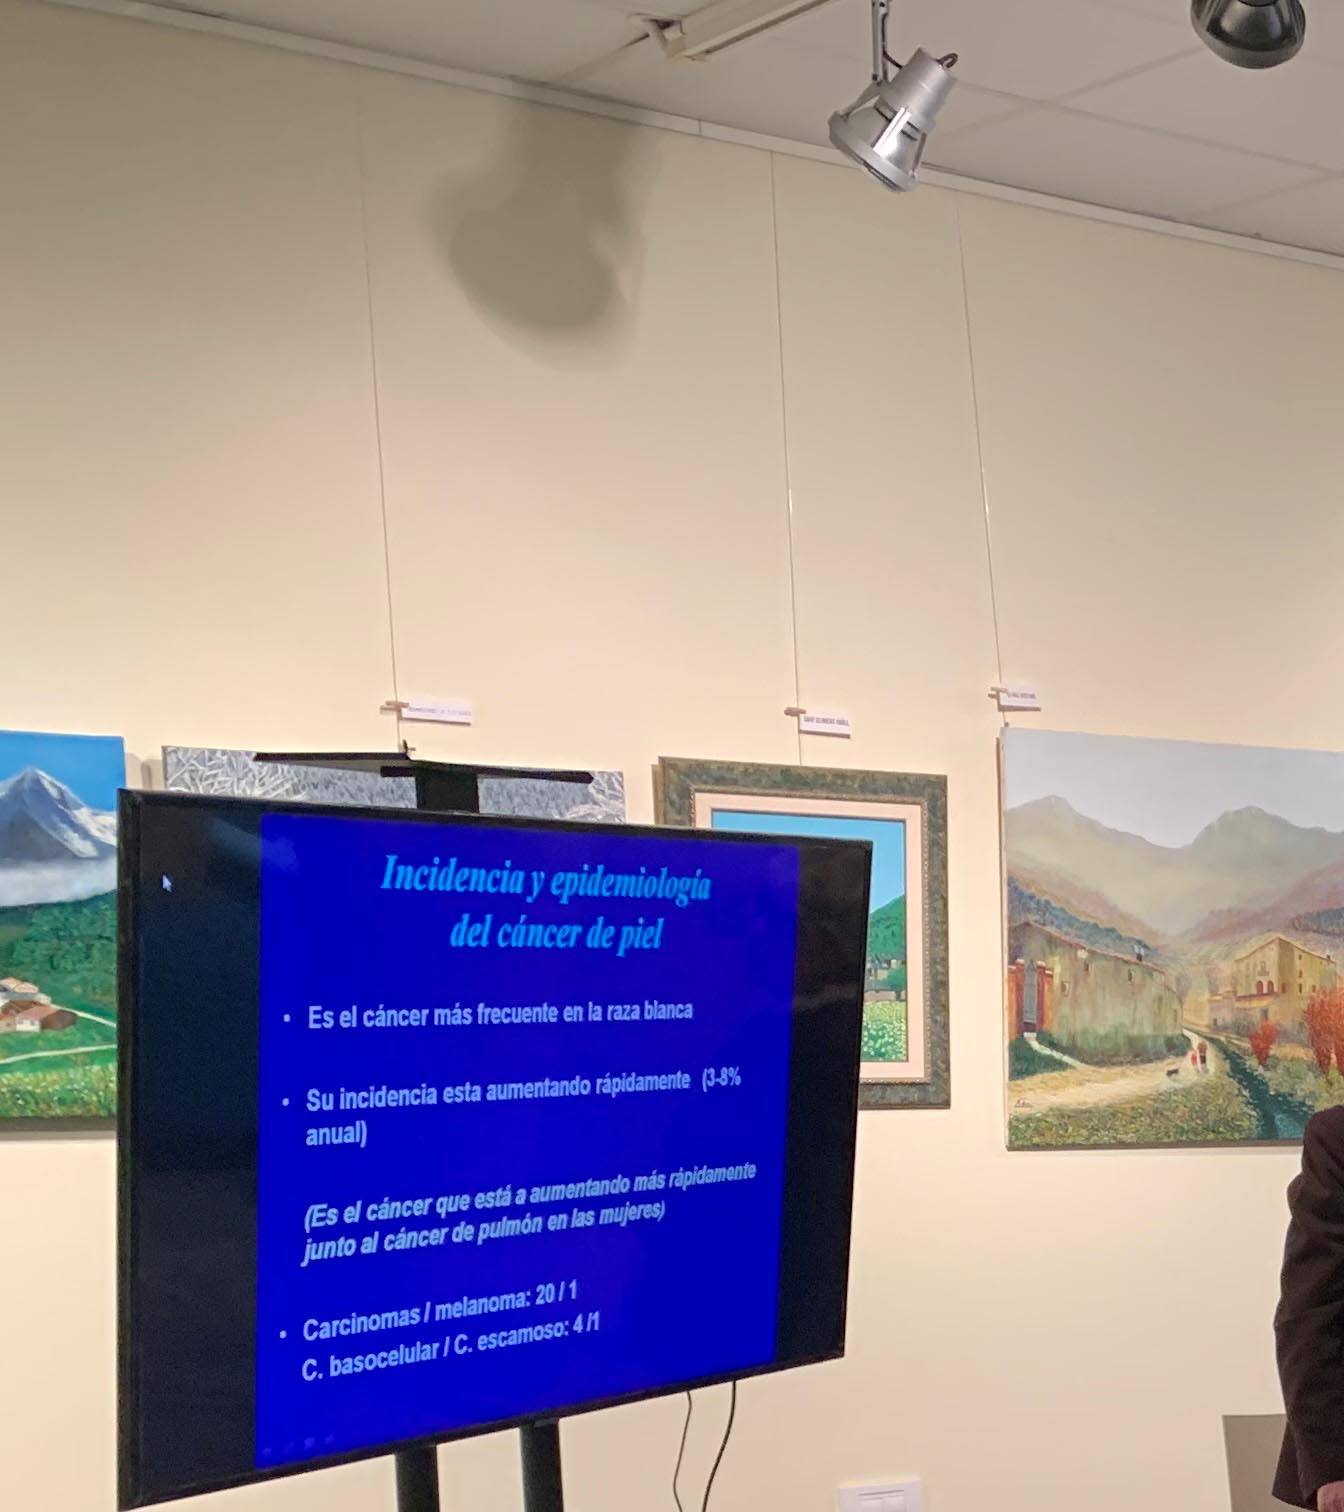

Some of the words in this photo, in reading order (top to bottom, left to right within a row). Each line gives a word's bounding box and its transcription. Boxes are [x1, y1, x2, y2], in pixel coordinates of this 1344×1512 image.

[380, 855, 525, 893] Incidencia
[526, 871, 545, 903] y
[550, 864, 712, 907] epidemiología
[450, 913, 493, 947] del
[497, 914, 582, 948] cáncer
[586, 916, 615, 948] de
[616, 917, 664, 957] piel
[308, 1005, 334, 1029] Es
[339, 1005, 357, 1028] el
[363, 1004, 429, 1027] cáncer
[434, 1002, 473, 1026] más
[477, 1002, 559, 1024] frecuente
[563, 1005, 583, 1023] en
[588, 1001, 602, 1022] la
[607, 1003, 640, 1021] raza
[644, 1000, 693, 1020] blanca
[306, 1088, 334, 1112] Su
[340, 1083, 437, 1110] incidencia
[443, 1081, 481, 1103] esta
[486, 1075, 591, 1101] aumentando
[596, 1070, 691, 1098] rápidamente
[702, 1066, 741, 1092] (3-8%
[306, 1120, 367, 1148] anual)
[304, 1204, 338, 1233] (Es
[343, 1200, 362, 1223] el
[366, 1196, 433, 1221] cáncer
[436, 1193, 470, 1219] que
[474, 1184, 511, 1209] está
[515, 1188, 527, 1205] a
[529, 1174, 630, 1203] aumentando
[633, 1169, 666, 1191] más
[669, 1161, 757, 1191] rápidamente
[300, 1238, 357, 1267] junto
[360, 1231, 379, 1254] al
[383, 1227, 449, 1251] cáncer
[451, 1221, 474, 1242] de
[477, 1212, 543, 1245] pulmón
[547, 1213, 568, 1231] en
[571, 1208, 595, 1228] las
[599, 1200, 666, 1227] mujeres)
[303, 1307, 420, 1341] Carcinomas
[423, 1301, 432, 1323] /
[435, 1290, 531, 1321] melanoma:
[535, 1282, 556, 1305] 20
[569, 1279, 577, 1299] 1
[302, 1358, 323, 1382] C.
[330, 1340, 440, 1377] basocelular
[454, 1334, 473, 1355] C.
[477, 1320, 570, 1350] escamoso:
[573, 1314, 584, 1333] 4
